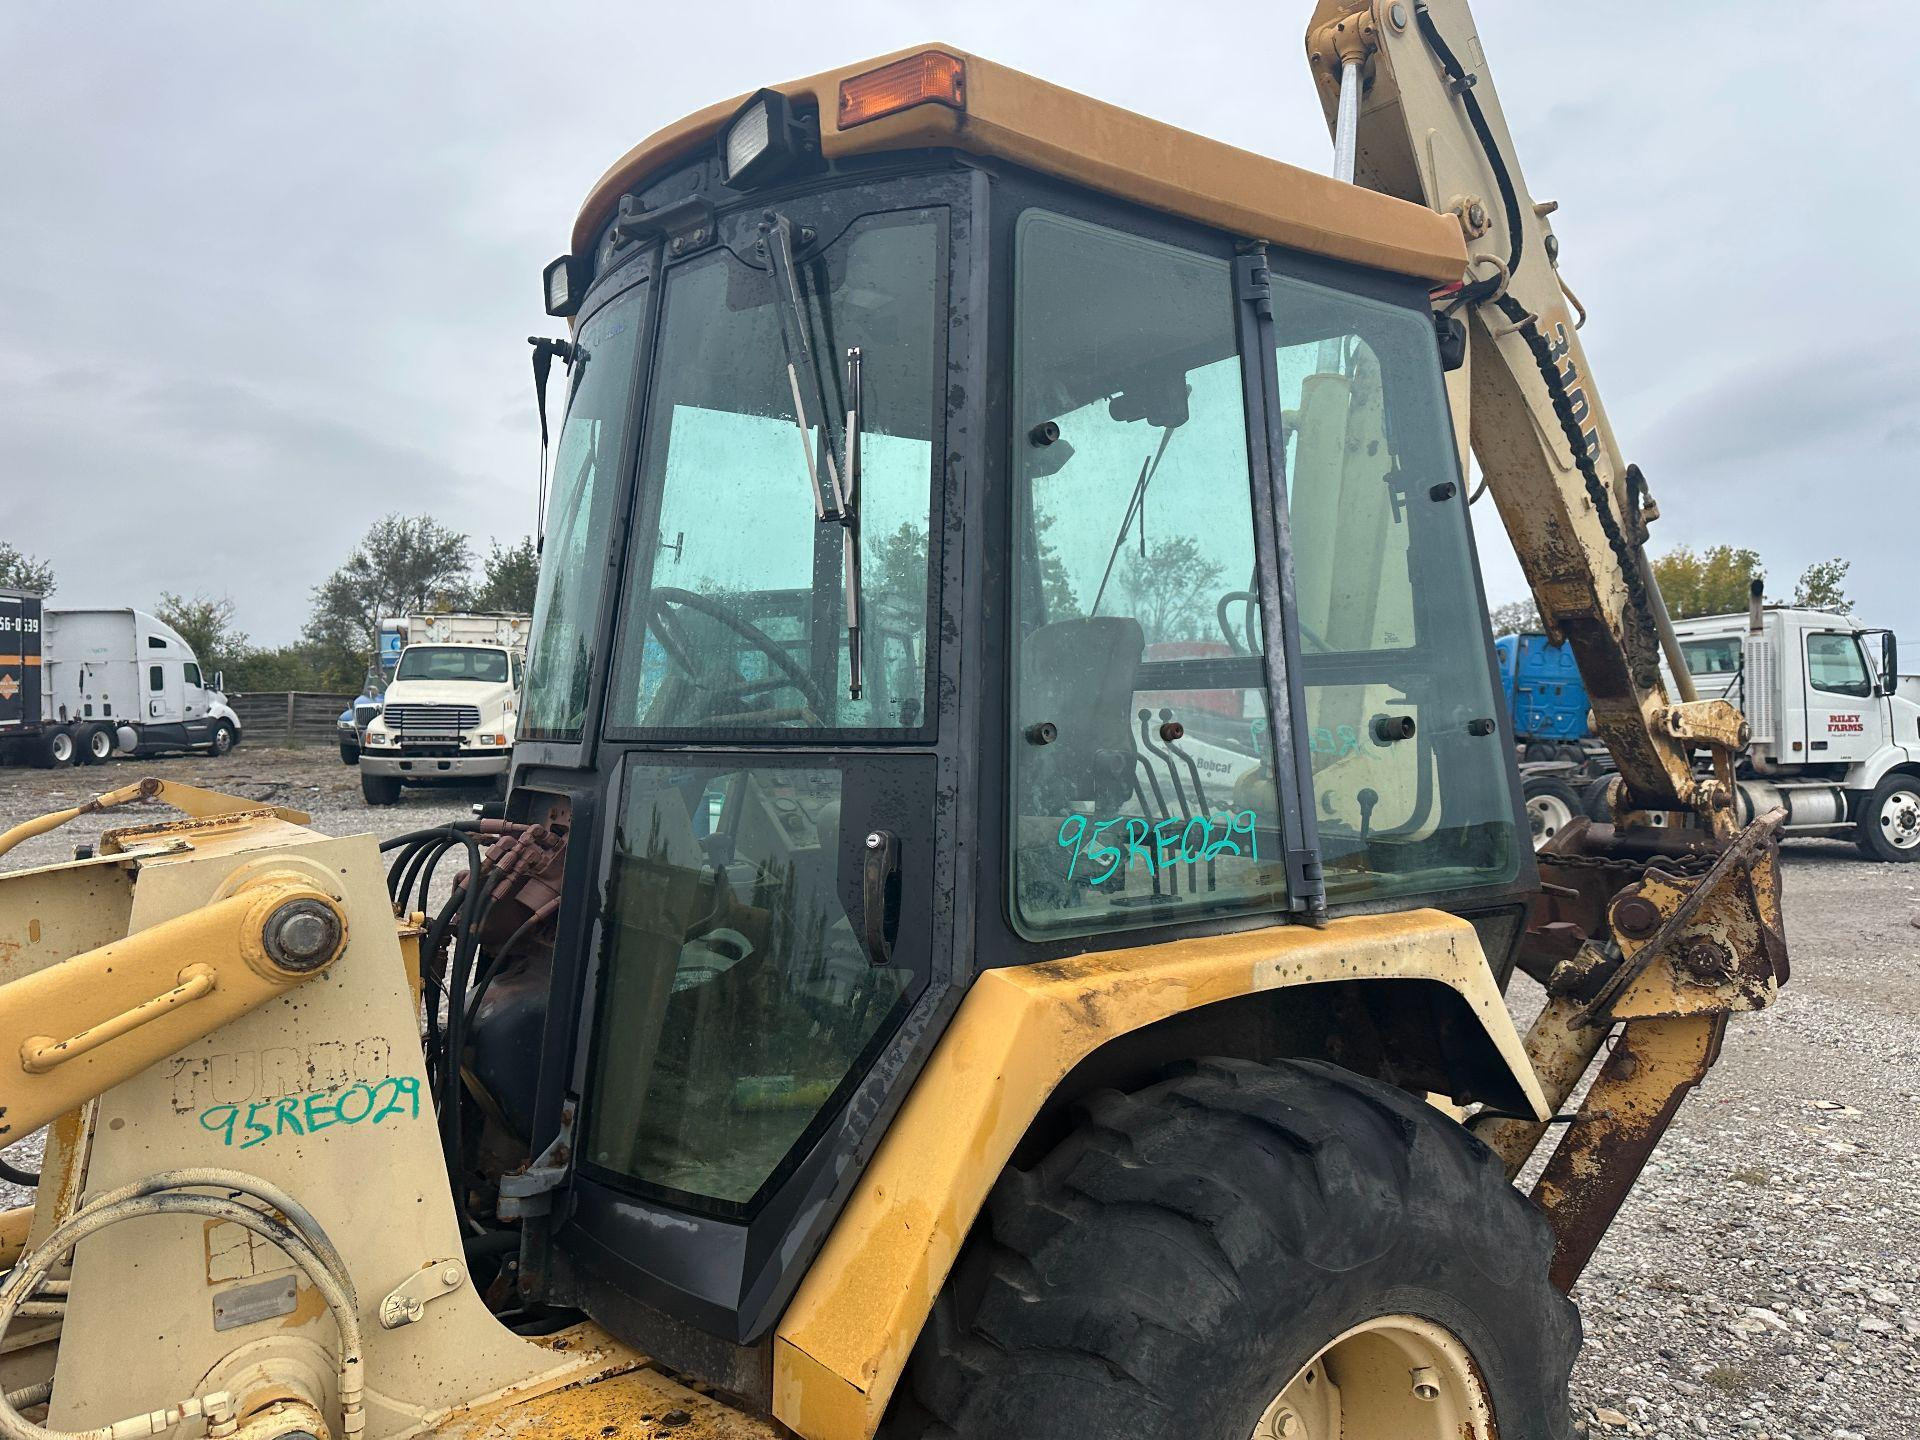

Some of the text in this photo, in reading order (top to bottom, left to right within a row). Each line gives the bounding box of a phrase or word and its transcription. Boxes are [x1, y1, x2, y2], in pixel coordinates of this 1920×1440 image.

[1829, 714, 1861, 723] RILEY
[1827, 723, 1864, 732] FARMS
[1196, 757, 1233, 774] Bobcat
[1058, 810, 1258, 885] 95RE029
[200, 1076, 420, 1149] 95RE029
